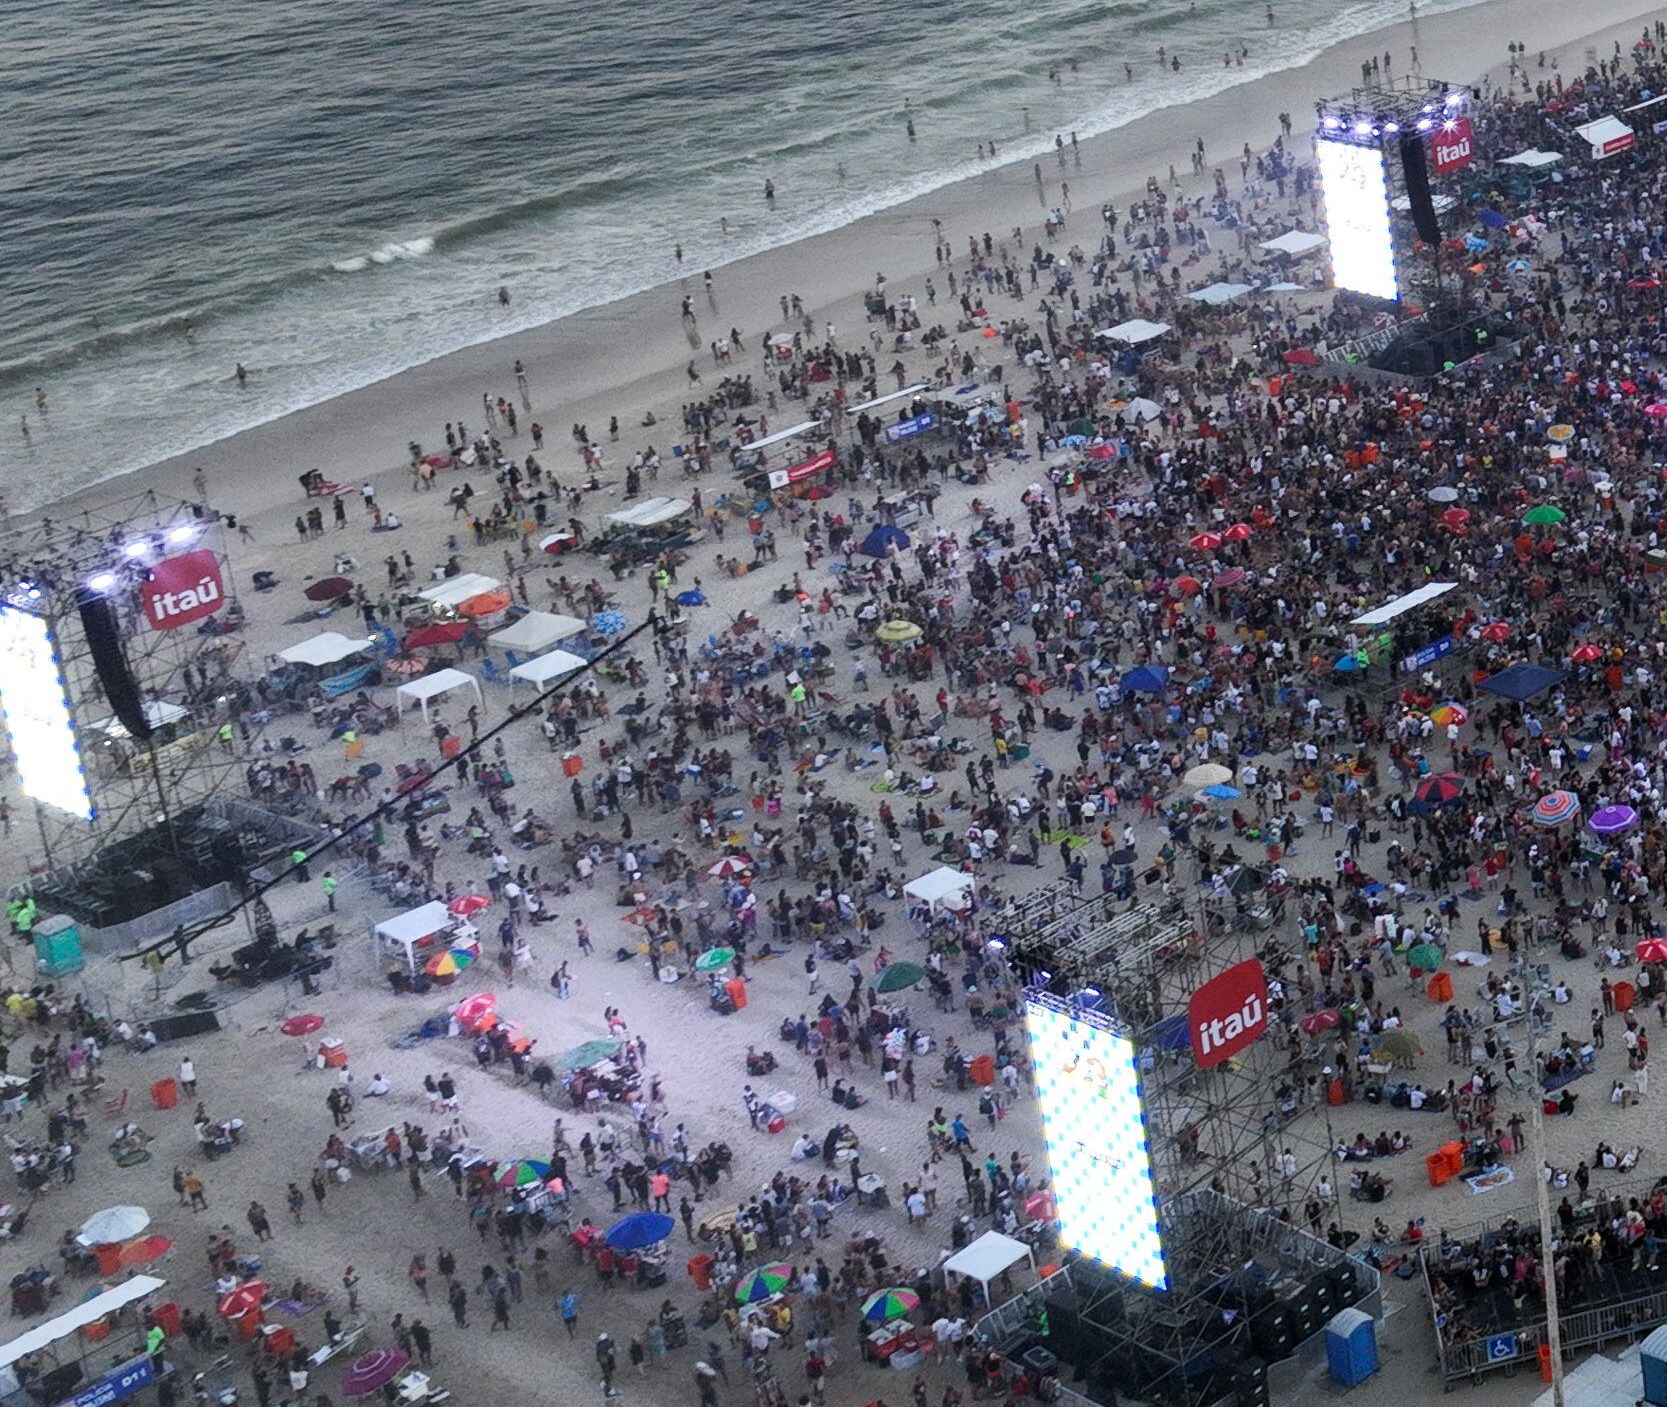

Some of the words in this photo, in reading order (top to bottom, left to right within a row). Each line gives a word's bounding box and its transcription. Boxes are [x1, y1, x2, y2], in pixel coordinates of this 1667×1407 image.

[1437, 137, 1471, 166] itaú
[151, 577, 219, 621] itaú
[1200, 993, 1262, 1055] itaú
